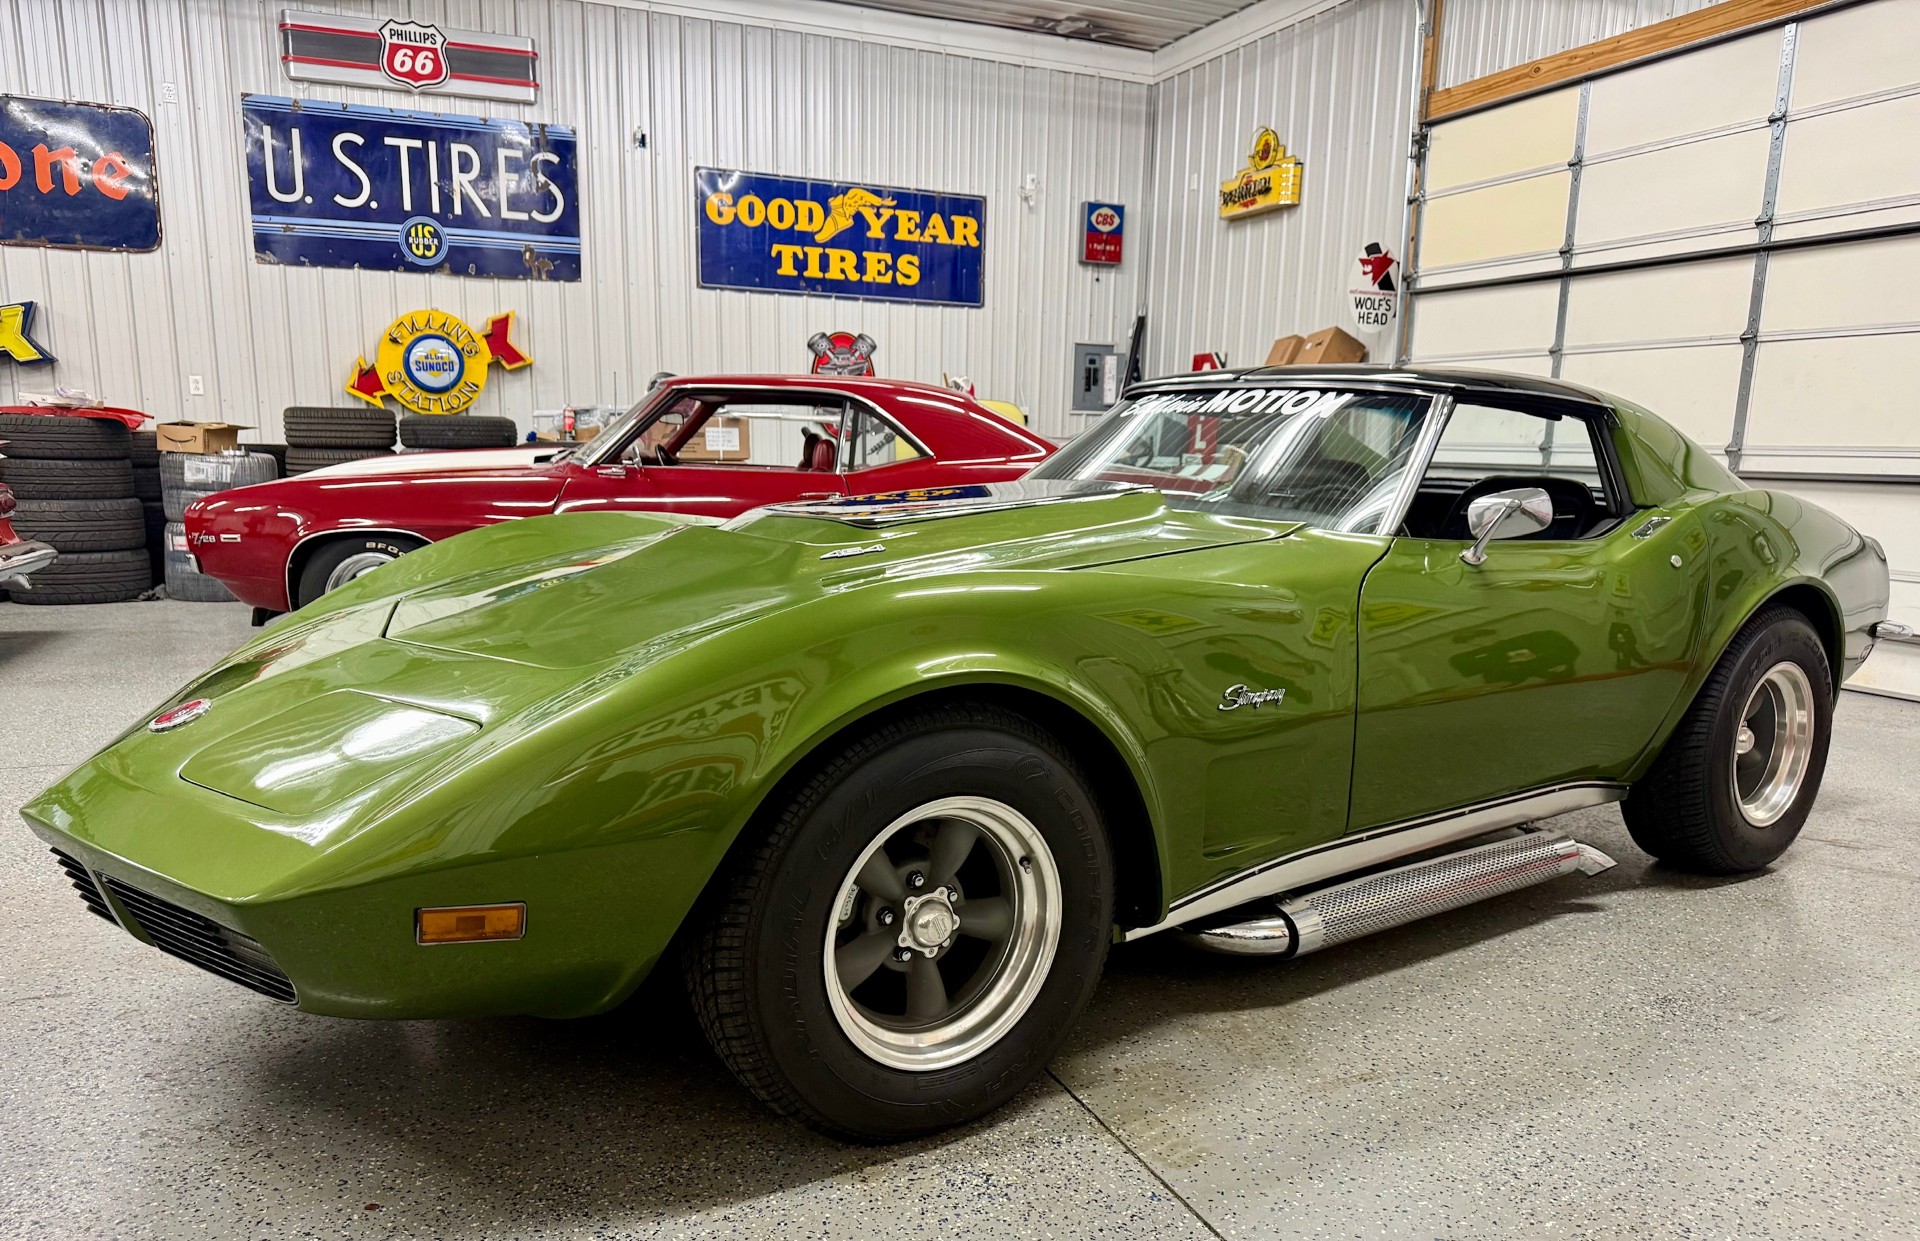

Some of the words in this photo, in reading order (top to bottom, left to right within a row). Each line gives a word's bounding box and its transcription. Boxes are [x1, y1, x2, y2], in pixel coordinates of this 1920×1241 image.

[389, 27, 438, 46] PHILLIPS
[393, 47, 435, 74] 66
[383, 136, 565, 223] TIRES
[1095, 212, 1116, 227] CBS
[408, 236, 440, 247] RUBBER
[770, 244, 921, 287] TIRES
[1354, 297, 1392, 312] WOLF'S
[1357, 311, 1388, 326] HEAD
[389, 312, 480, 358] FILLING
[415, 360, 455, 373] SUNOCO
[387, 369, 480, 413] STATION
[1196, 388, 1355, 419] MOTION
[1218, 683, 1286, 711] Stingray
